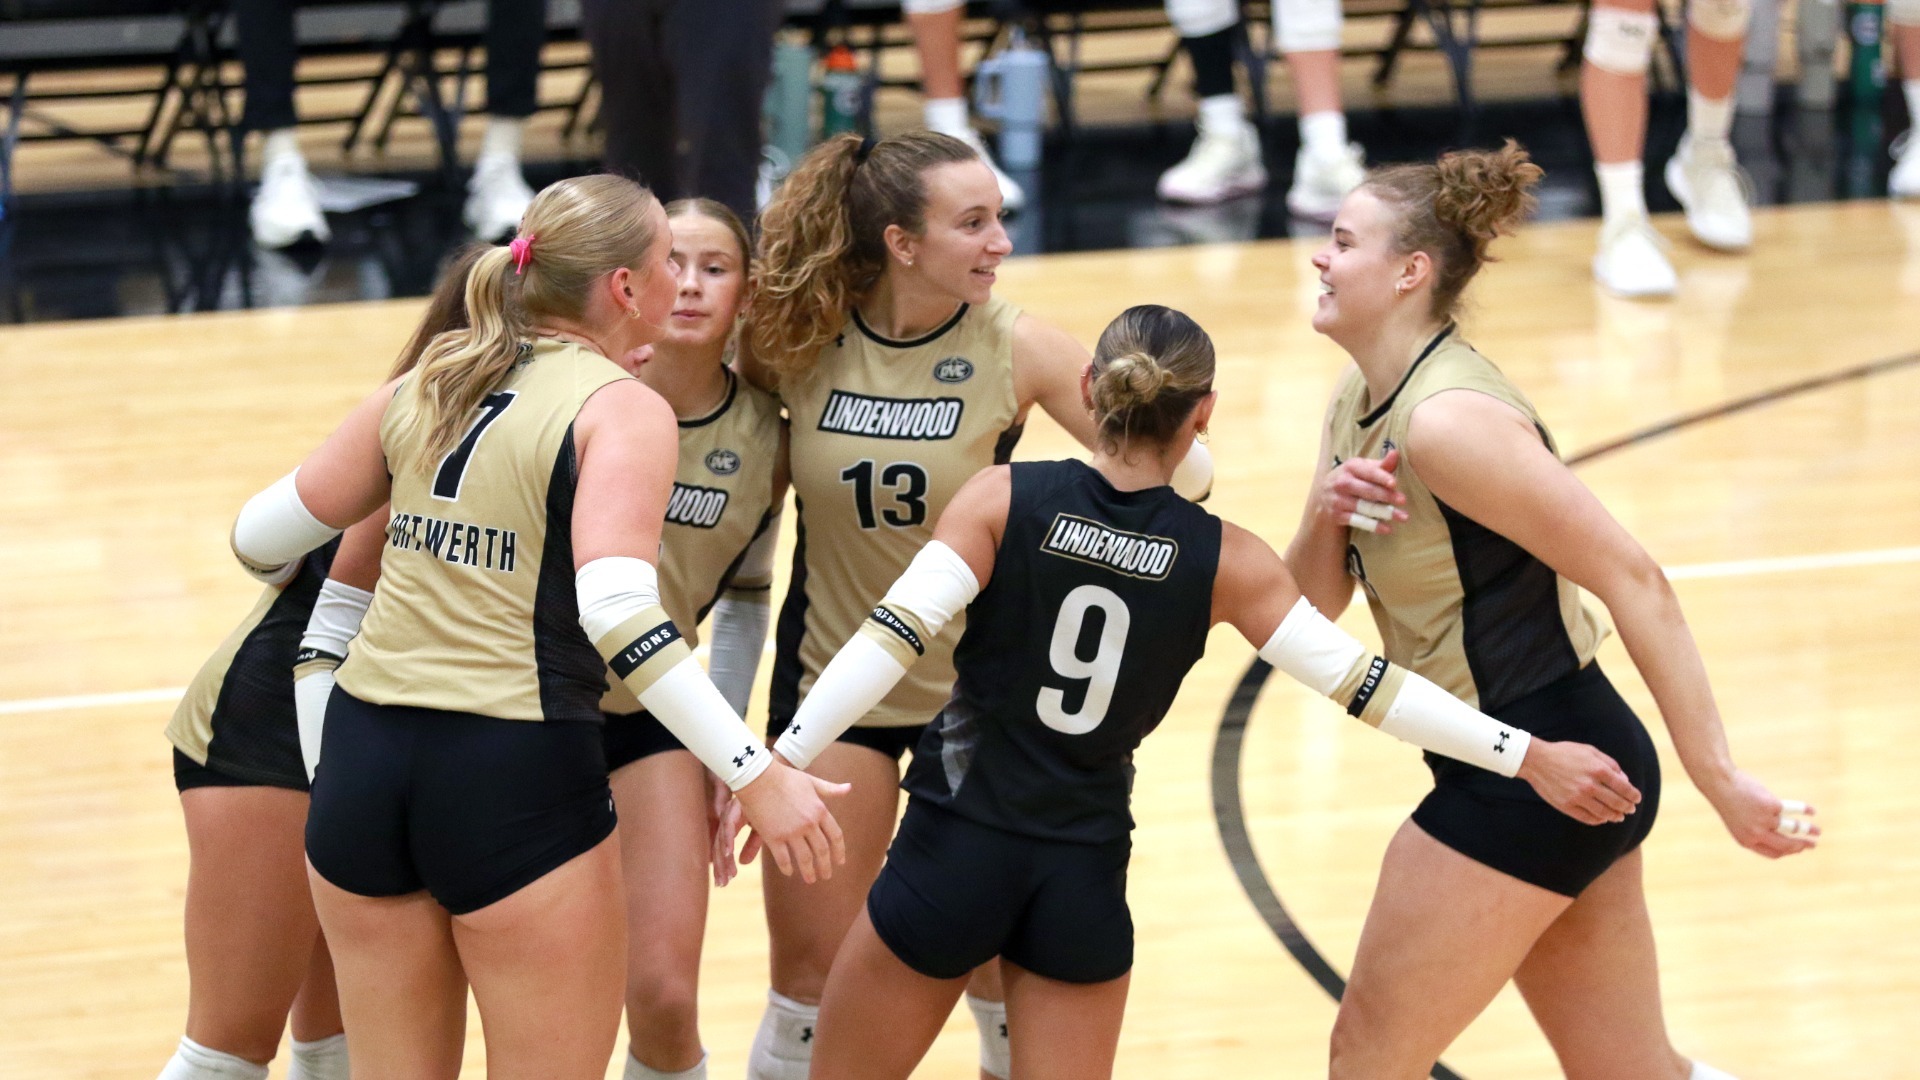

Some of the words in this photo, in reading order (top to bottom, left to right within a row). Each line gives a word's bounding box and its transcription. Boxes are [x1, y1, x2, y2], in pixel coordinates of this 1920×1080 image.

[821, 393, 961, 437] LINDENWOOD
[430, 389, 519, 503] 7
[840, 458, 929, 531] 13
[1048, 518, 1174, 576] LINDENWOOD
[625, 628, 672, 664] LIONS
[1036, 584, 1131, 736] 9
[1357, 659, 1384, 701] LIONS
